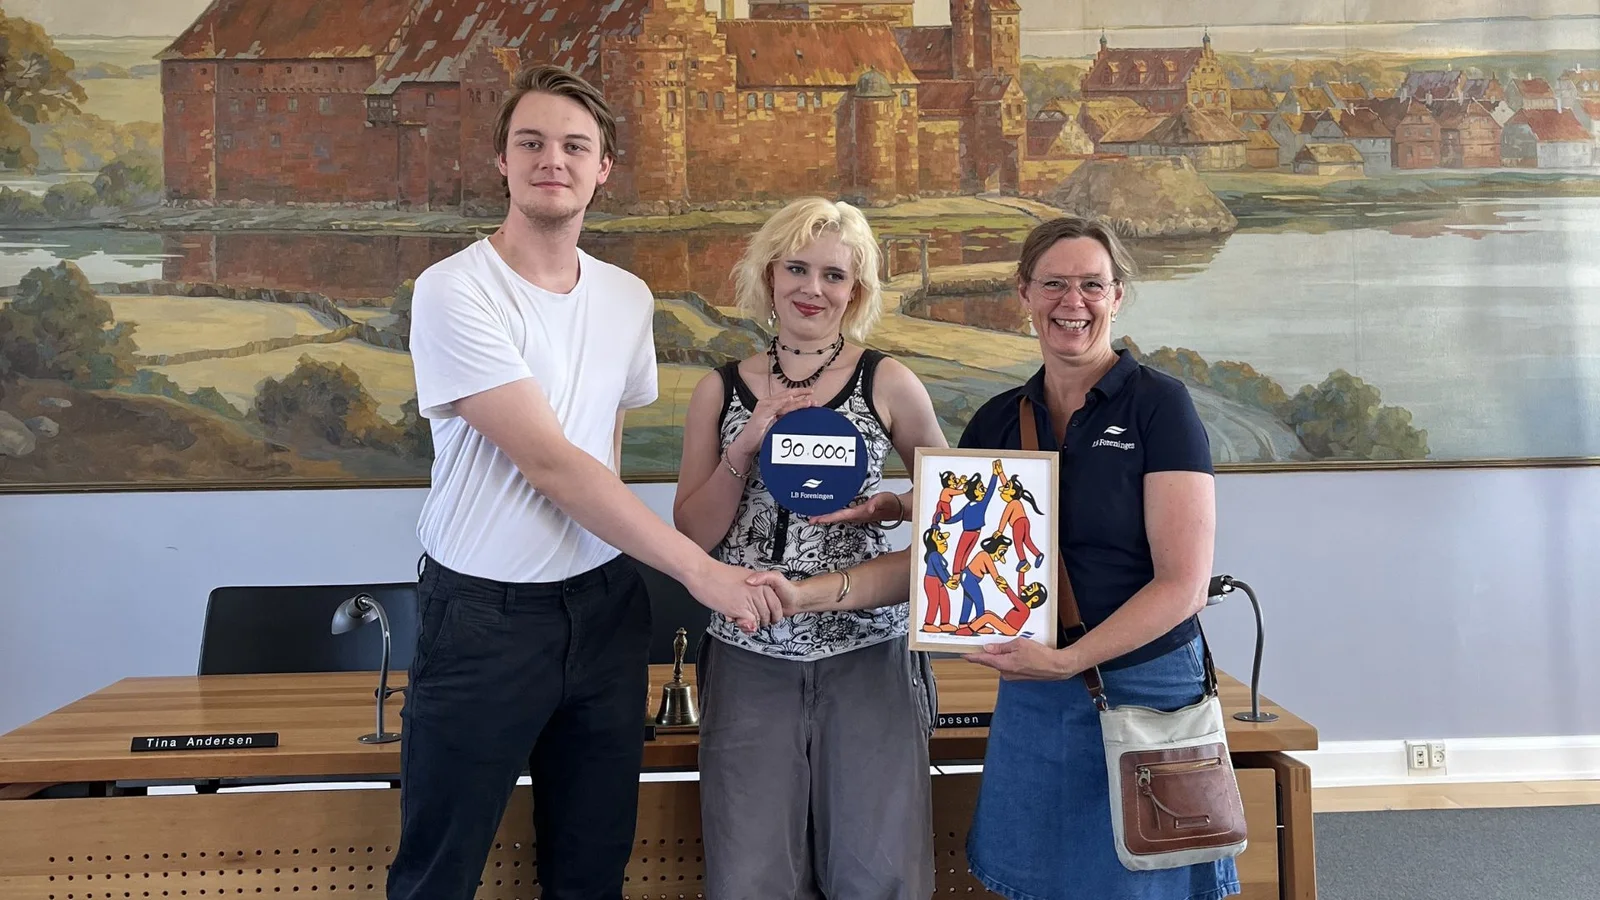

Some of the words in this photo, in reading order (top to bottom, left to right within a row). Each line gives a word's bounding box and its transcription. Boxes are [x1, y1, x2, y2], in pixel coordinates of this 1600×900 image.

[1099, 438, 1135, 450] Foreningen
[790, 491, 799, 499] LB
[800, 492, 834, 500] Foreningen
[939, 716, 979, 726] pesen
[146, 738, 177, 748] Tina
[186, 736, 253, 747] Andersen
